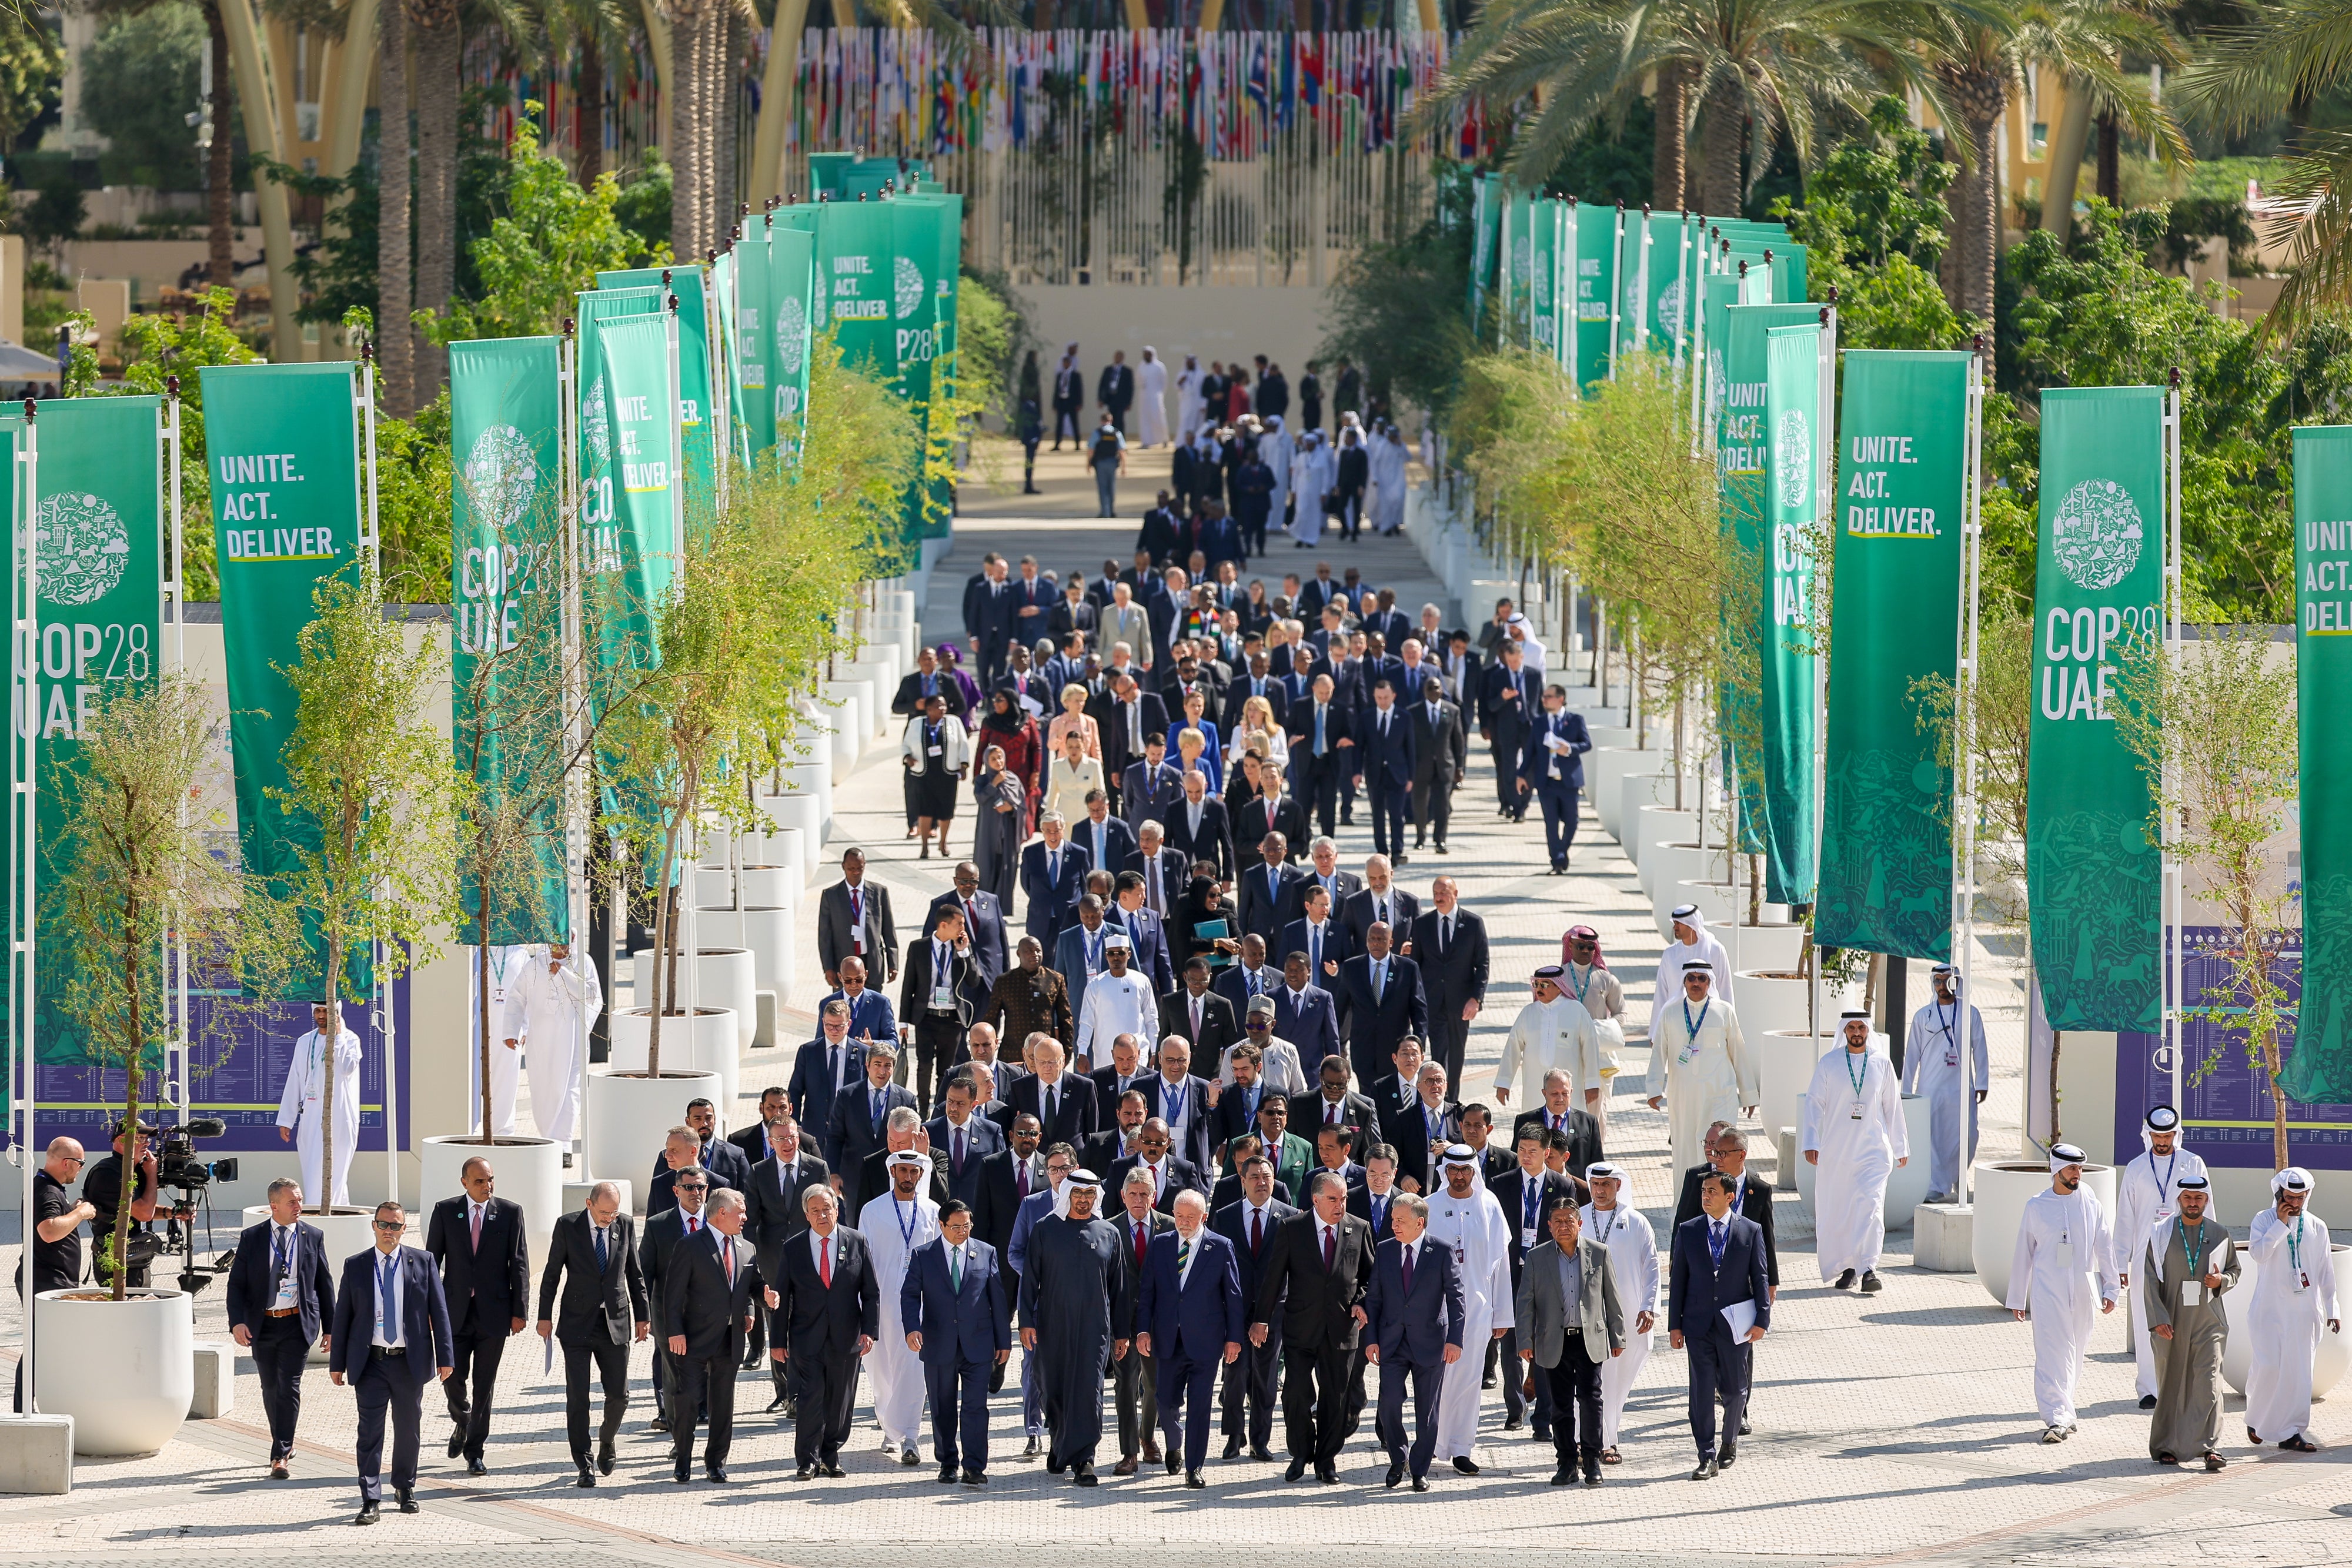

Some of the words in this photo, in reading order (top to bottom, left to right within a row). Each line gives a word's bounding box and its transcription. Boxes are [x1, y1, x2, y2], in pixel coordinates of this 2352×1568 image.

[834, 256, 873, 274] UNITE.
[1579, 259, 1601, 276] UNITE.
[834, 278, 861, 296] ACT.
[1579, 280, 1593, 297] ACT.
[834, 300, 888, 317] DELIVER.
[1579, 302, 1610, 319] DELIVER.
[775, 384, 801, 419] COP
[1726, 414, 1762, 439] ACT.
[1853, 436, 1918, 463] UNITE.
[220, 454, 305, 484] UNITE.
[623, 462, 669, 489] DELIVER.
[1848, 472, 1890, 499] ACT.
[223, 492, 277, 521] ACT.
[1848, 506, 1942, 535] DELIVER.
[227, 527, 341, 558] DELIVER.
[462, 543, 552, 598] COP28
[1774, 576, 1806, 626] UAE
[460, 600, 518, 653] UAE
[2046, 606, 2156, 662] COP28
[17, 623, 149, 681] COP28
[2042, 666, 2117, 720] UAE
[16, 684, 101, 740] UAE
